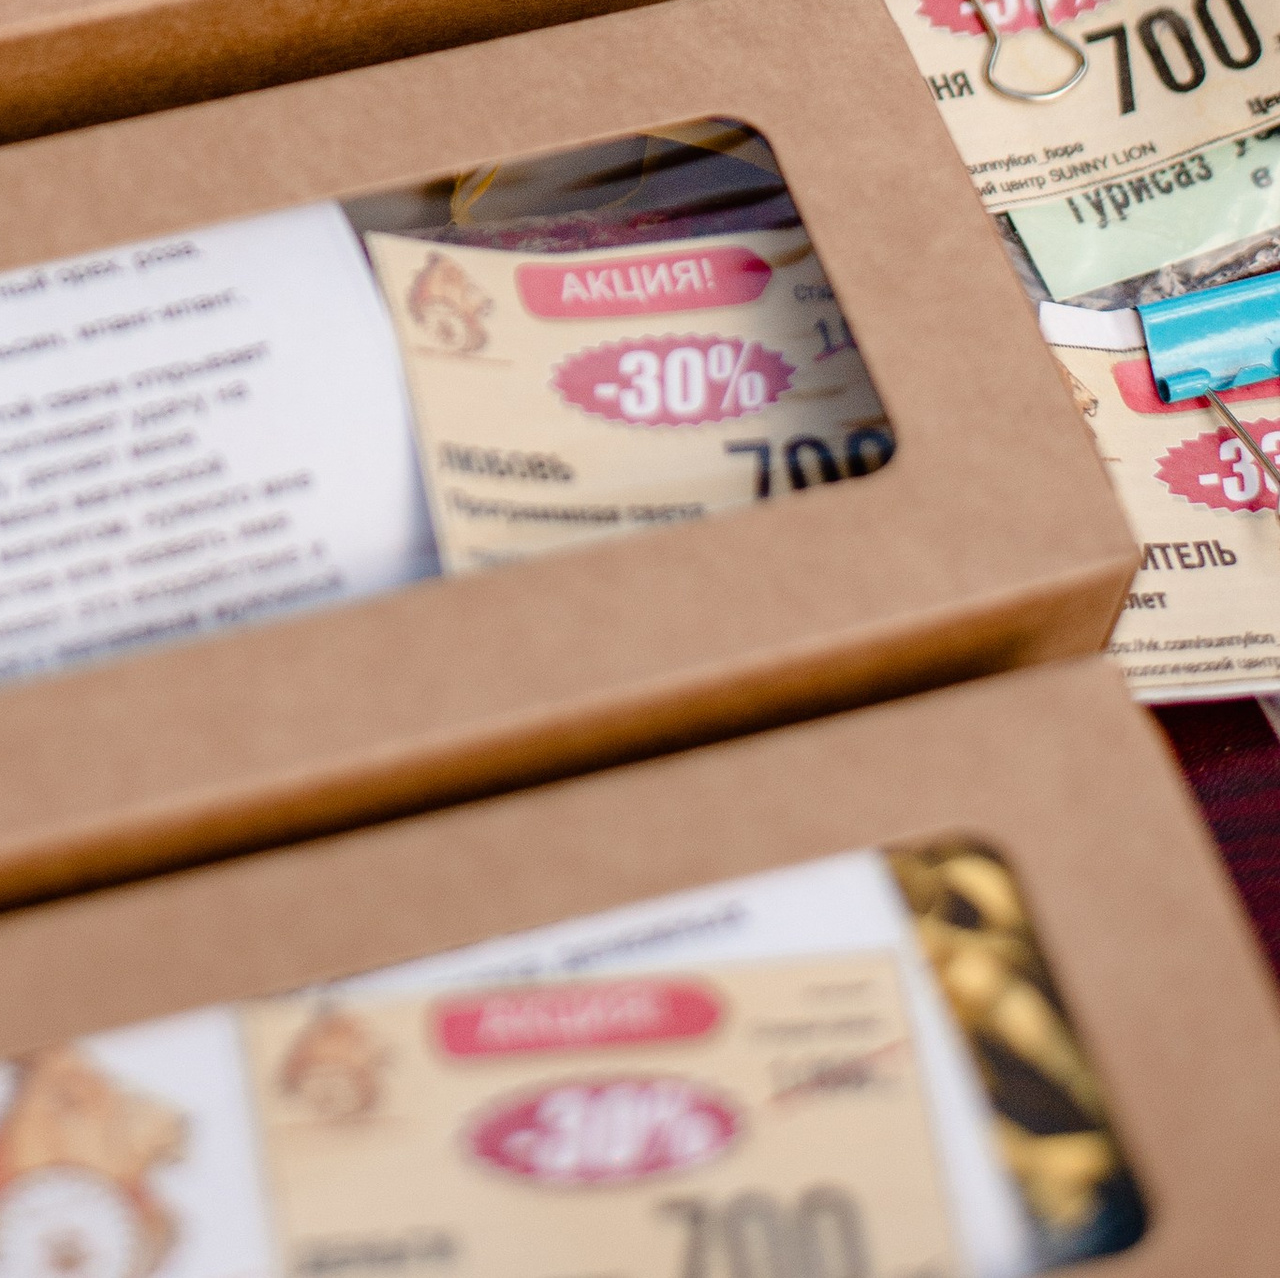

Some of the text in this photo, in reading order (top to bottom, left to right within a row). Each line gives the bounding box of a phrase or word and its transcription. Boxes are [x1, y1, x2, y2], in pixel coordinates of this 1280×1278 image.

[924, 70, 975, 101] НЯ
[1048, 154, 1110, 183] SUNNY
[1112, 141, 1158, 166] LION
[561, 258, 717, 303] АКЦИЯ!
[593, 342, 767, 418] -30%
[723, 430, 897, 499] 700
[504, 1079, 715, 1175] -30%
